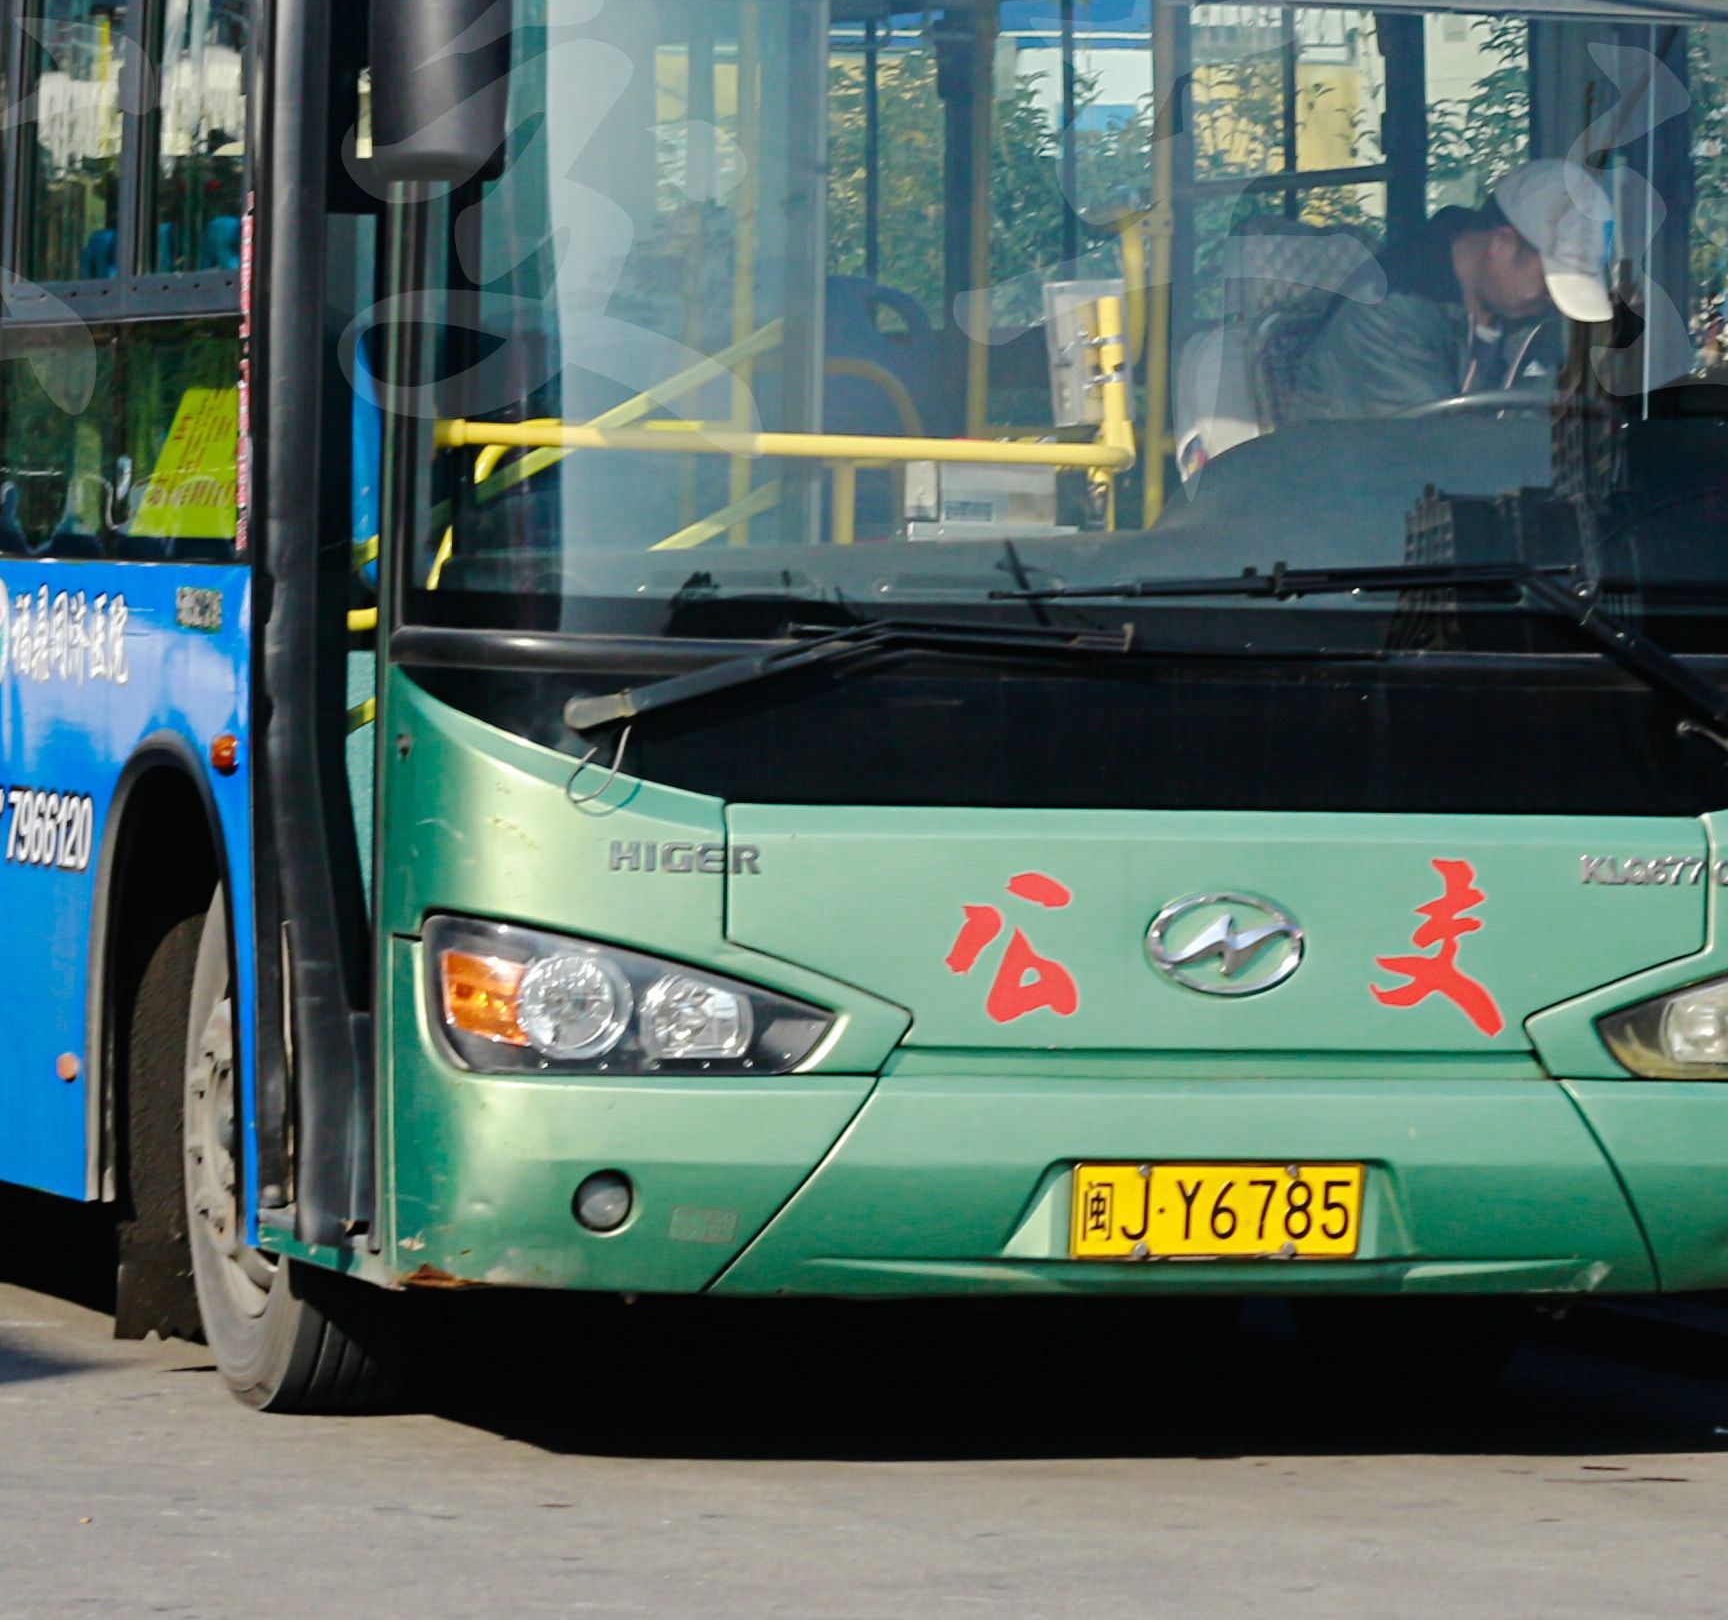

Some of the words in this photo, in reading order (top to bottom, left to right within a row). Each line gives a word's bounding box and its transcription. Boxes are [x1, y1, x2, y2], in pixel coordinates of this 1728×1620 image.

[10, 582, 129, 688] 福鼎同济医院
[6, 788, 94, 871] 7966120
[608, 840, 762, 876] HIGER
[942, 871, 1080, 1024] 公
[1368, 857, 1504, 1038] 交
